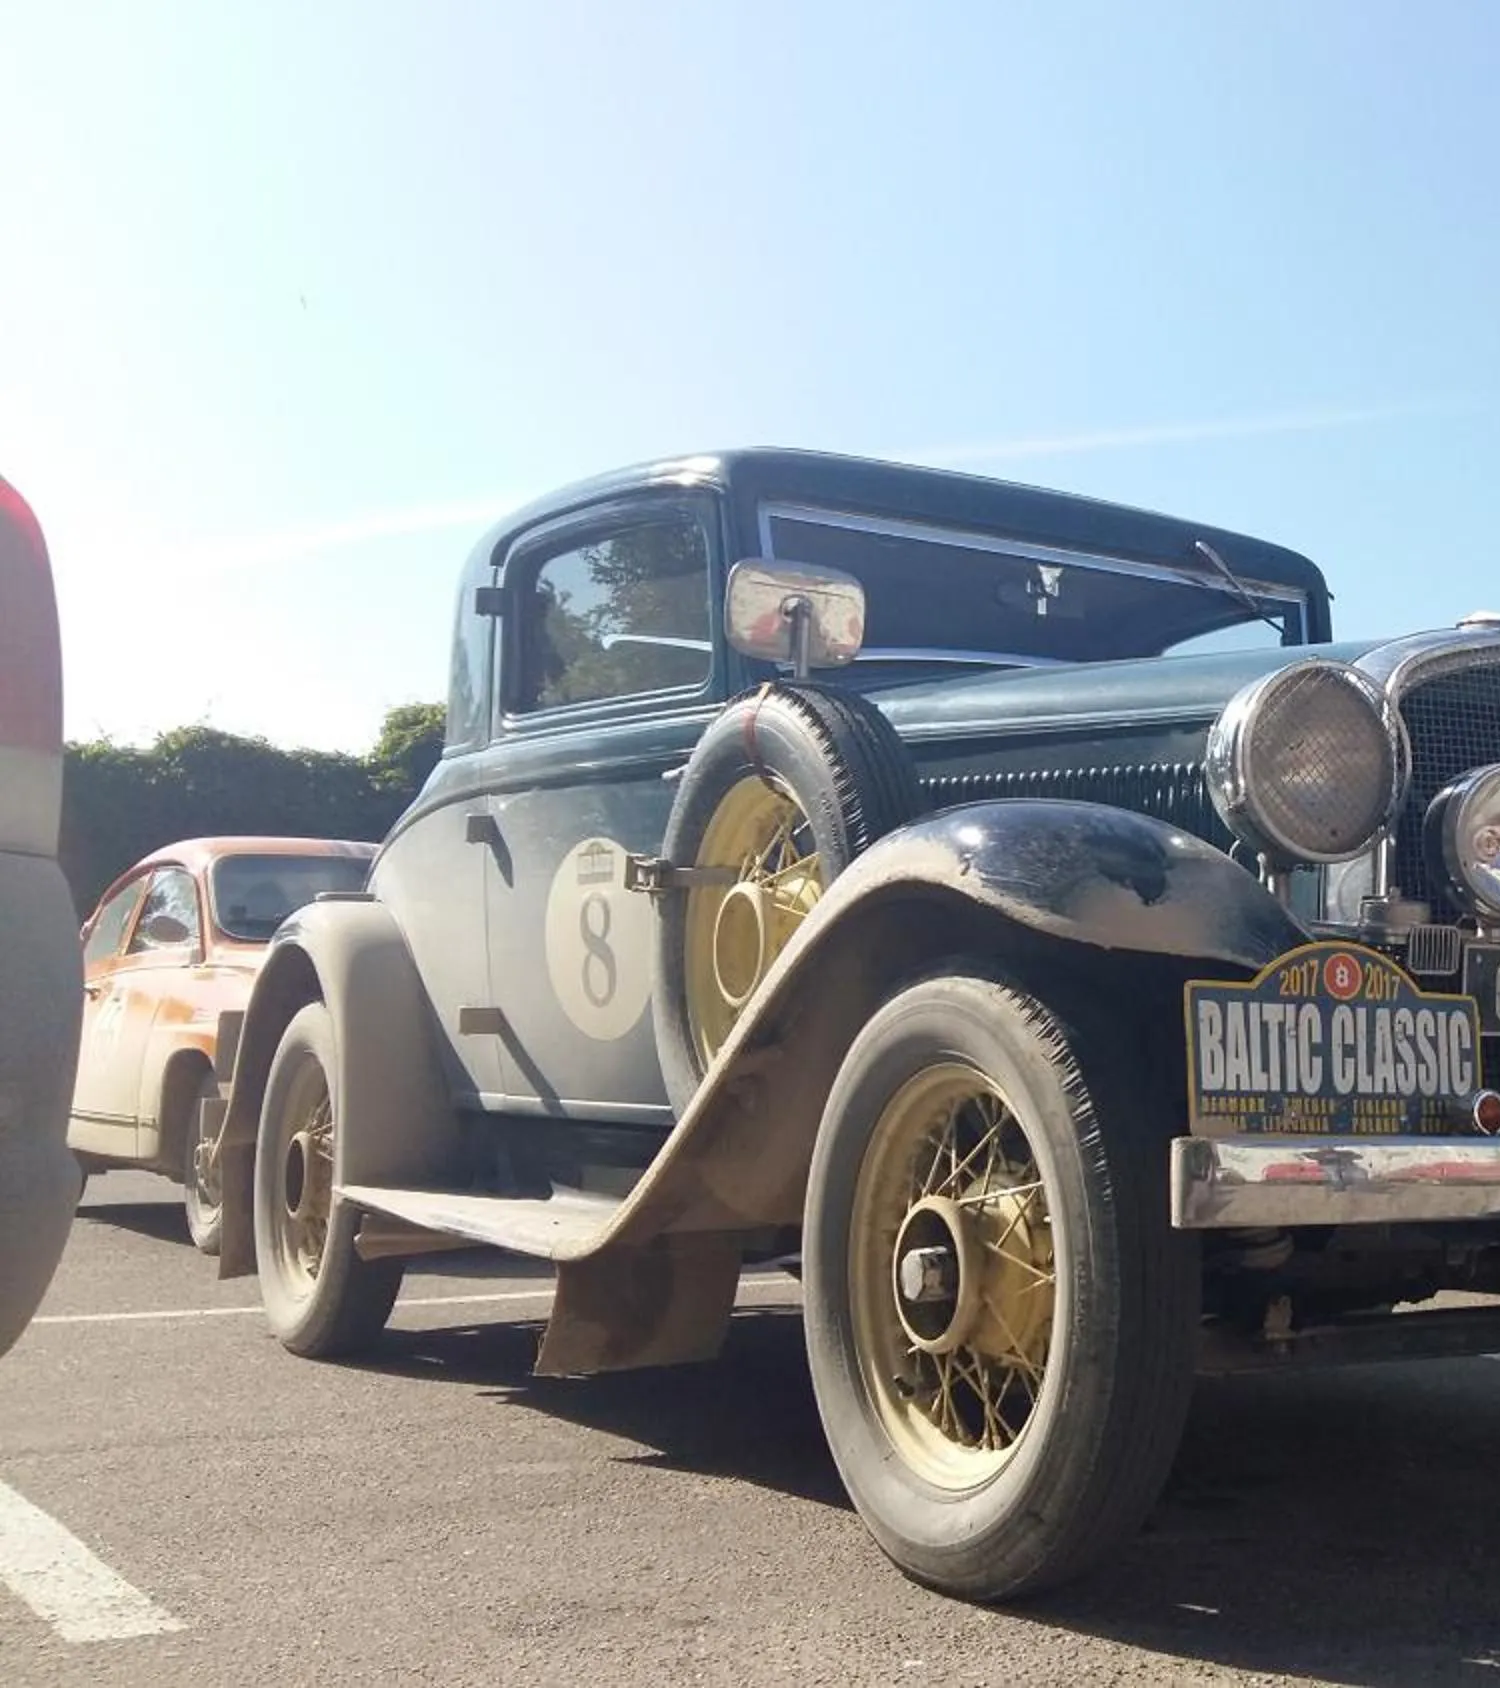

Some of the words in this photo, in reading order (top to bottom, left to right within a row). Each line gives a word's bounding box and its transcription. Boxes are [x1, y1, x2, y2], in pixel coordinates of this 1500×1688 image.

[580, 891, 617, 1008] 8
[1279, 960, 1319, 997] 2017
[1335, 964, 1350, 988] 8
[1365, 961, 1400, 1000] 2017
[1200, 1000, 1323, 1095] BALTIC
[1331, 1003, 1472, 1097] CLASSIC
